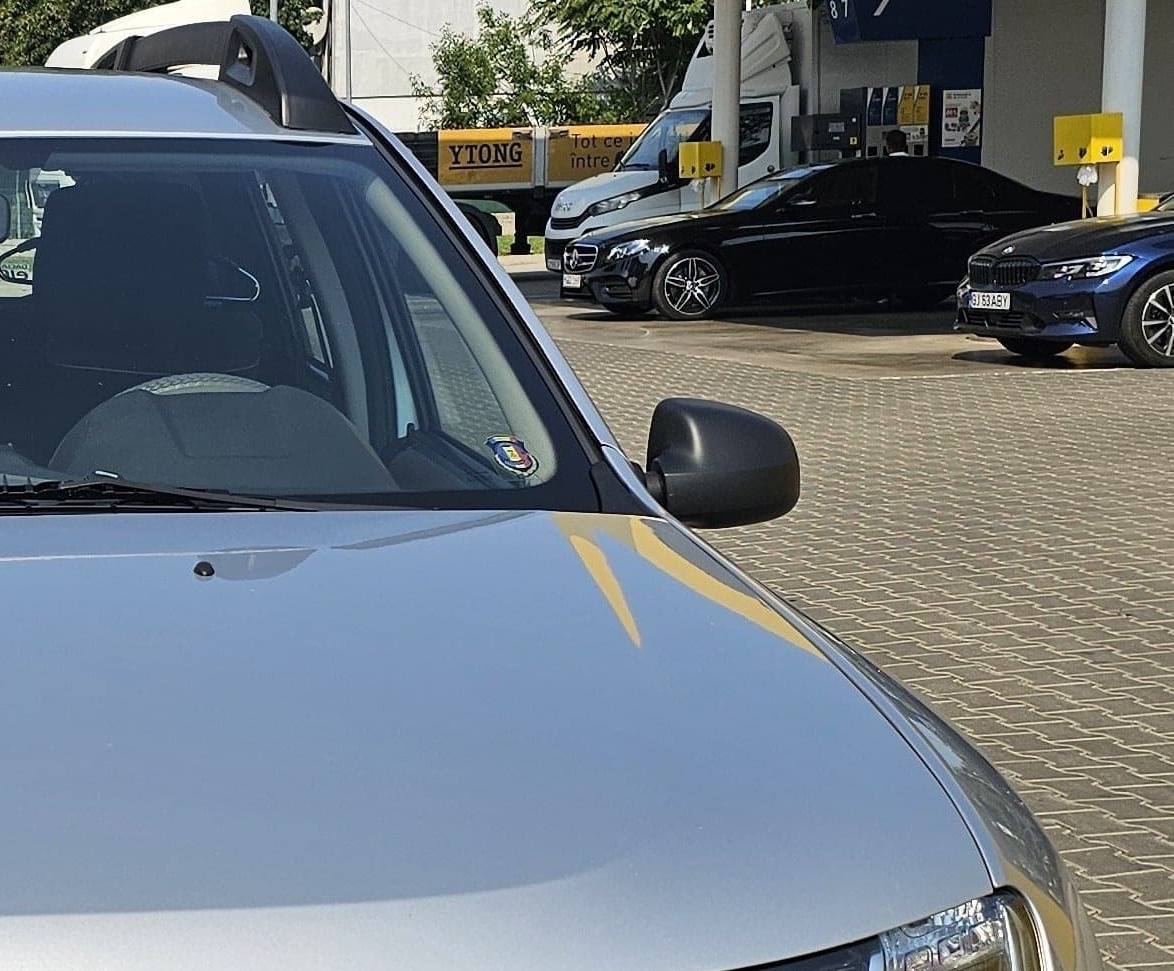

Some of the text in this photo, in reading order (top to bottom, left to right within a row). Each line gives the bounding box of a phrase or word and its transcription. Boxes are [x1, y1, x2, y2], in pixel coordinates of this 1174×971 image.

[571, 132, 596, 149] Tot
[604, 136, 623, 148] ce
[449, 143, 523, 165] YTONG
[570, 152, 610, 169] între
